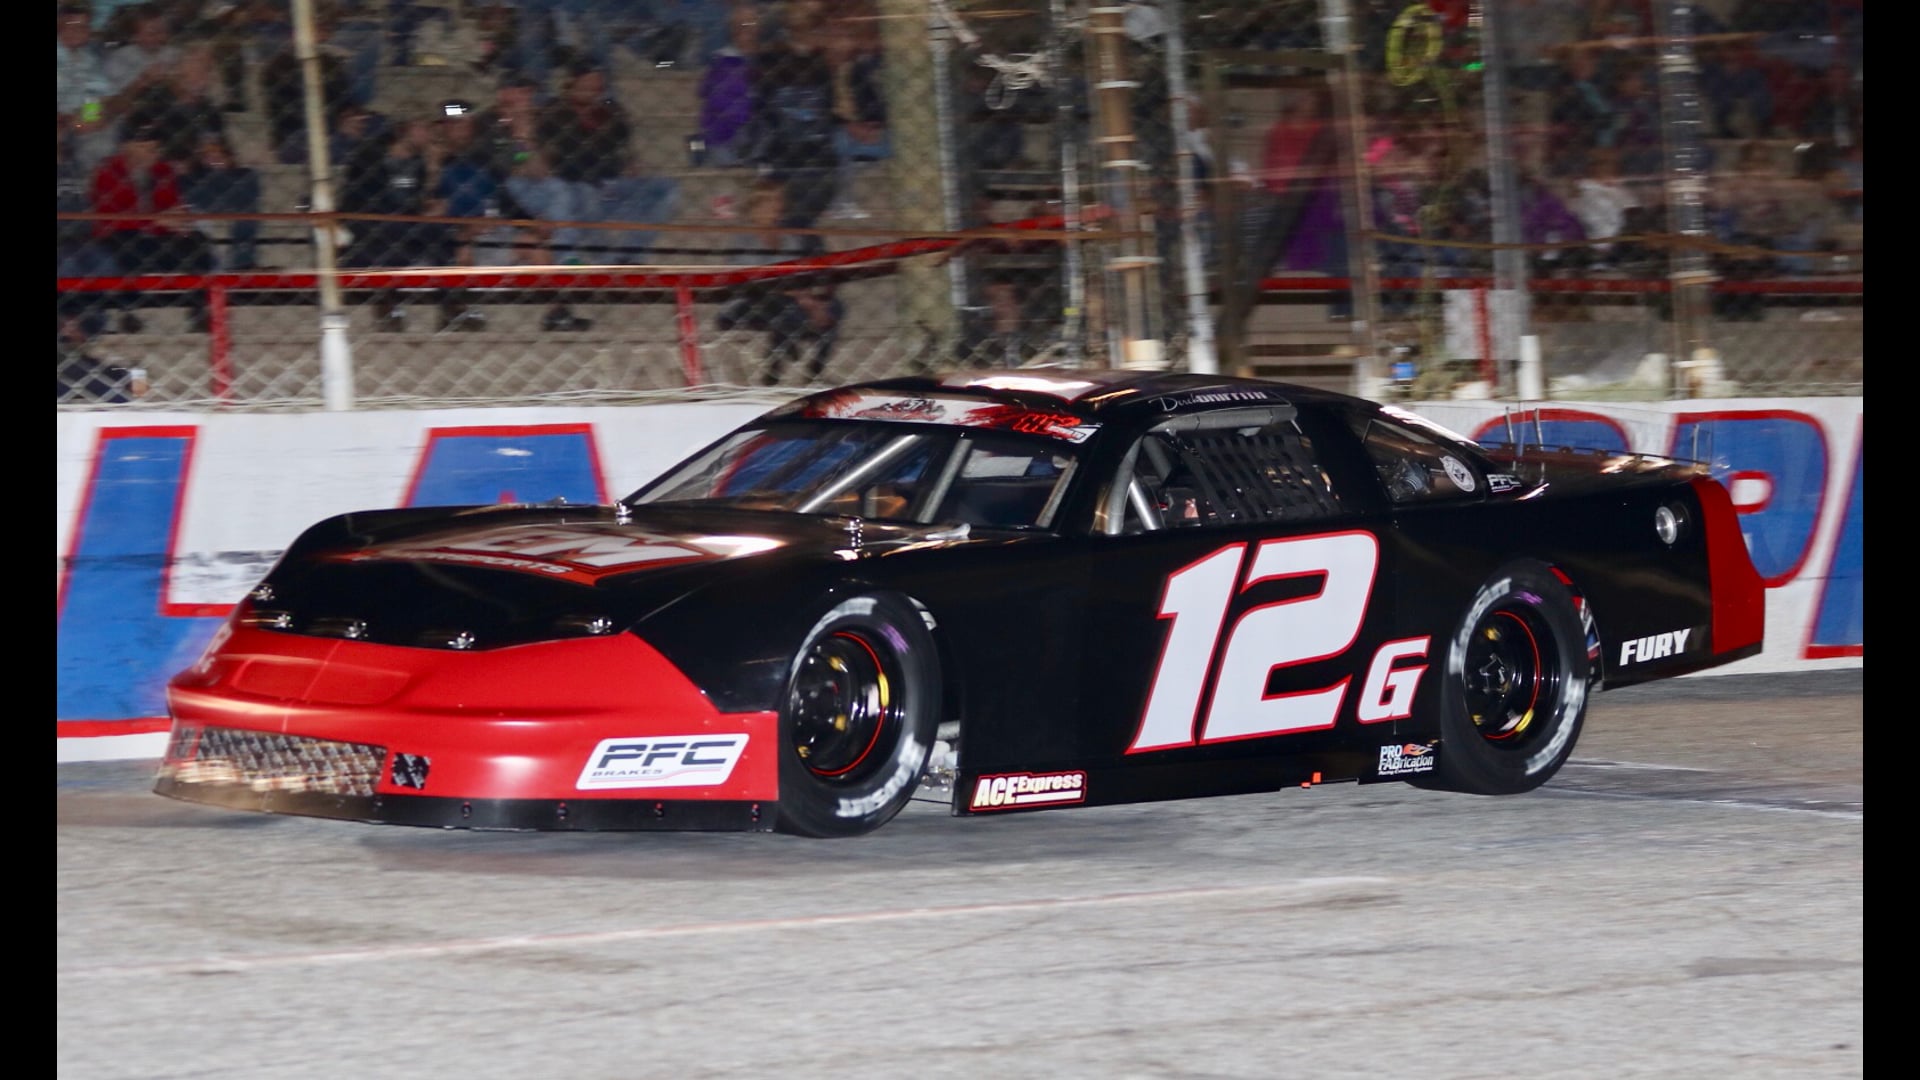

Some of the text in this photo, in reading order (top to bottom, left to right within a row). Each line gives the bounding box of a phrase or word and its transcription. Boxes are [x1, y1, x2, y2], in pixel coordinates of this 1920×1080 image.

[1124, 530, 1380, 755] 12
[1357, 635, 1431, 725] G
[1619, 628, 1691, 667] FURY
[597, 740, 737, 769] PFC
[1377, 755, 1434, 771] FABrication
[1380, 745, 1403, 759] PRO
[592, 768, 663, 777] BRAKES
[973, 774, 1083, 807] ACE Express
